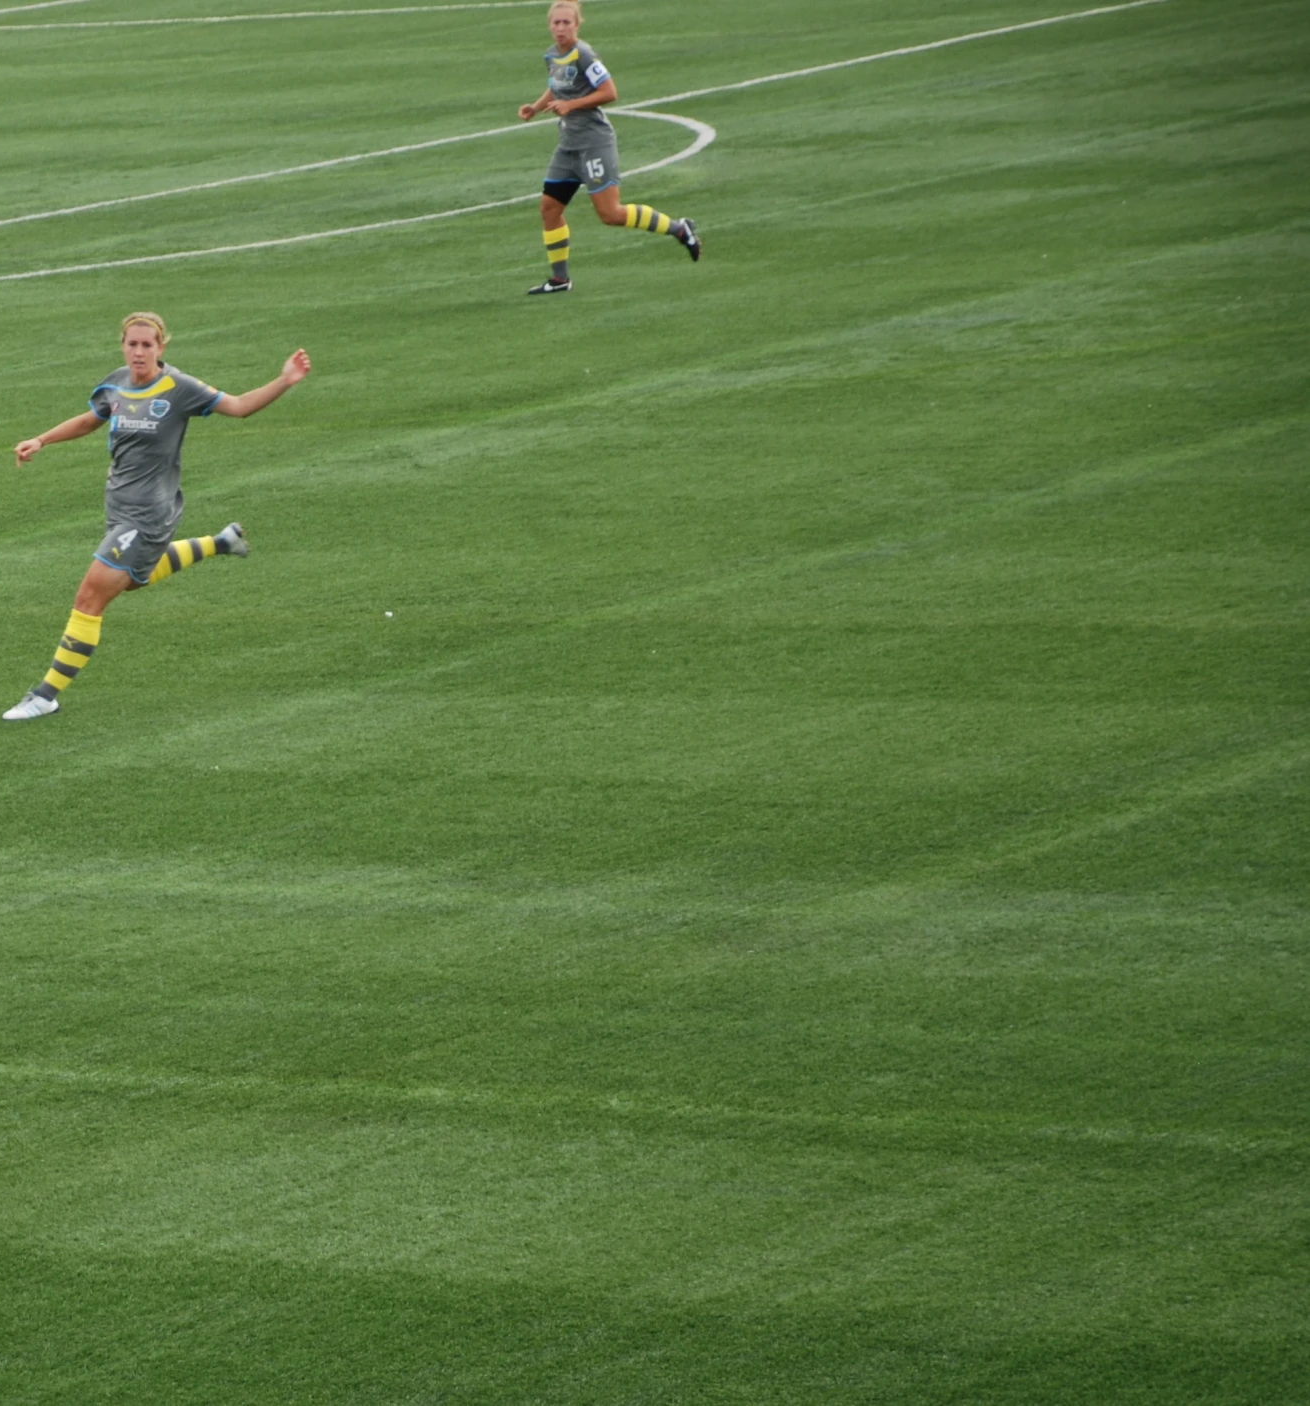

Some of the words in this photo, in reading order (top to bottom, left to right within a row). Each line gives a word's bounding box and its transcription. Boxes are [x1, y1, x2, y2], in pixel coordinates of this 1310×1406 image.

[592, 65, 603, 76] C
[586, 157, 605, 179] 15
[117, 414, 159, 430] Premier
[117, 529, 139, 551] 4
